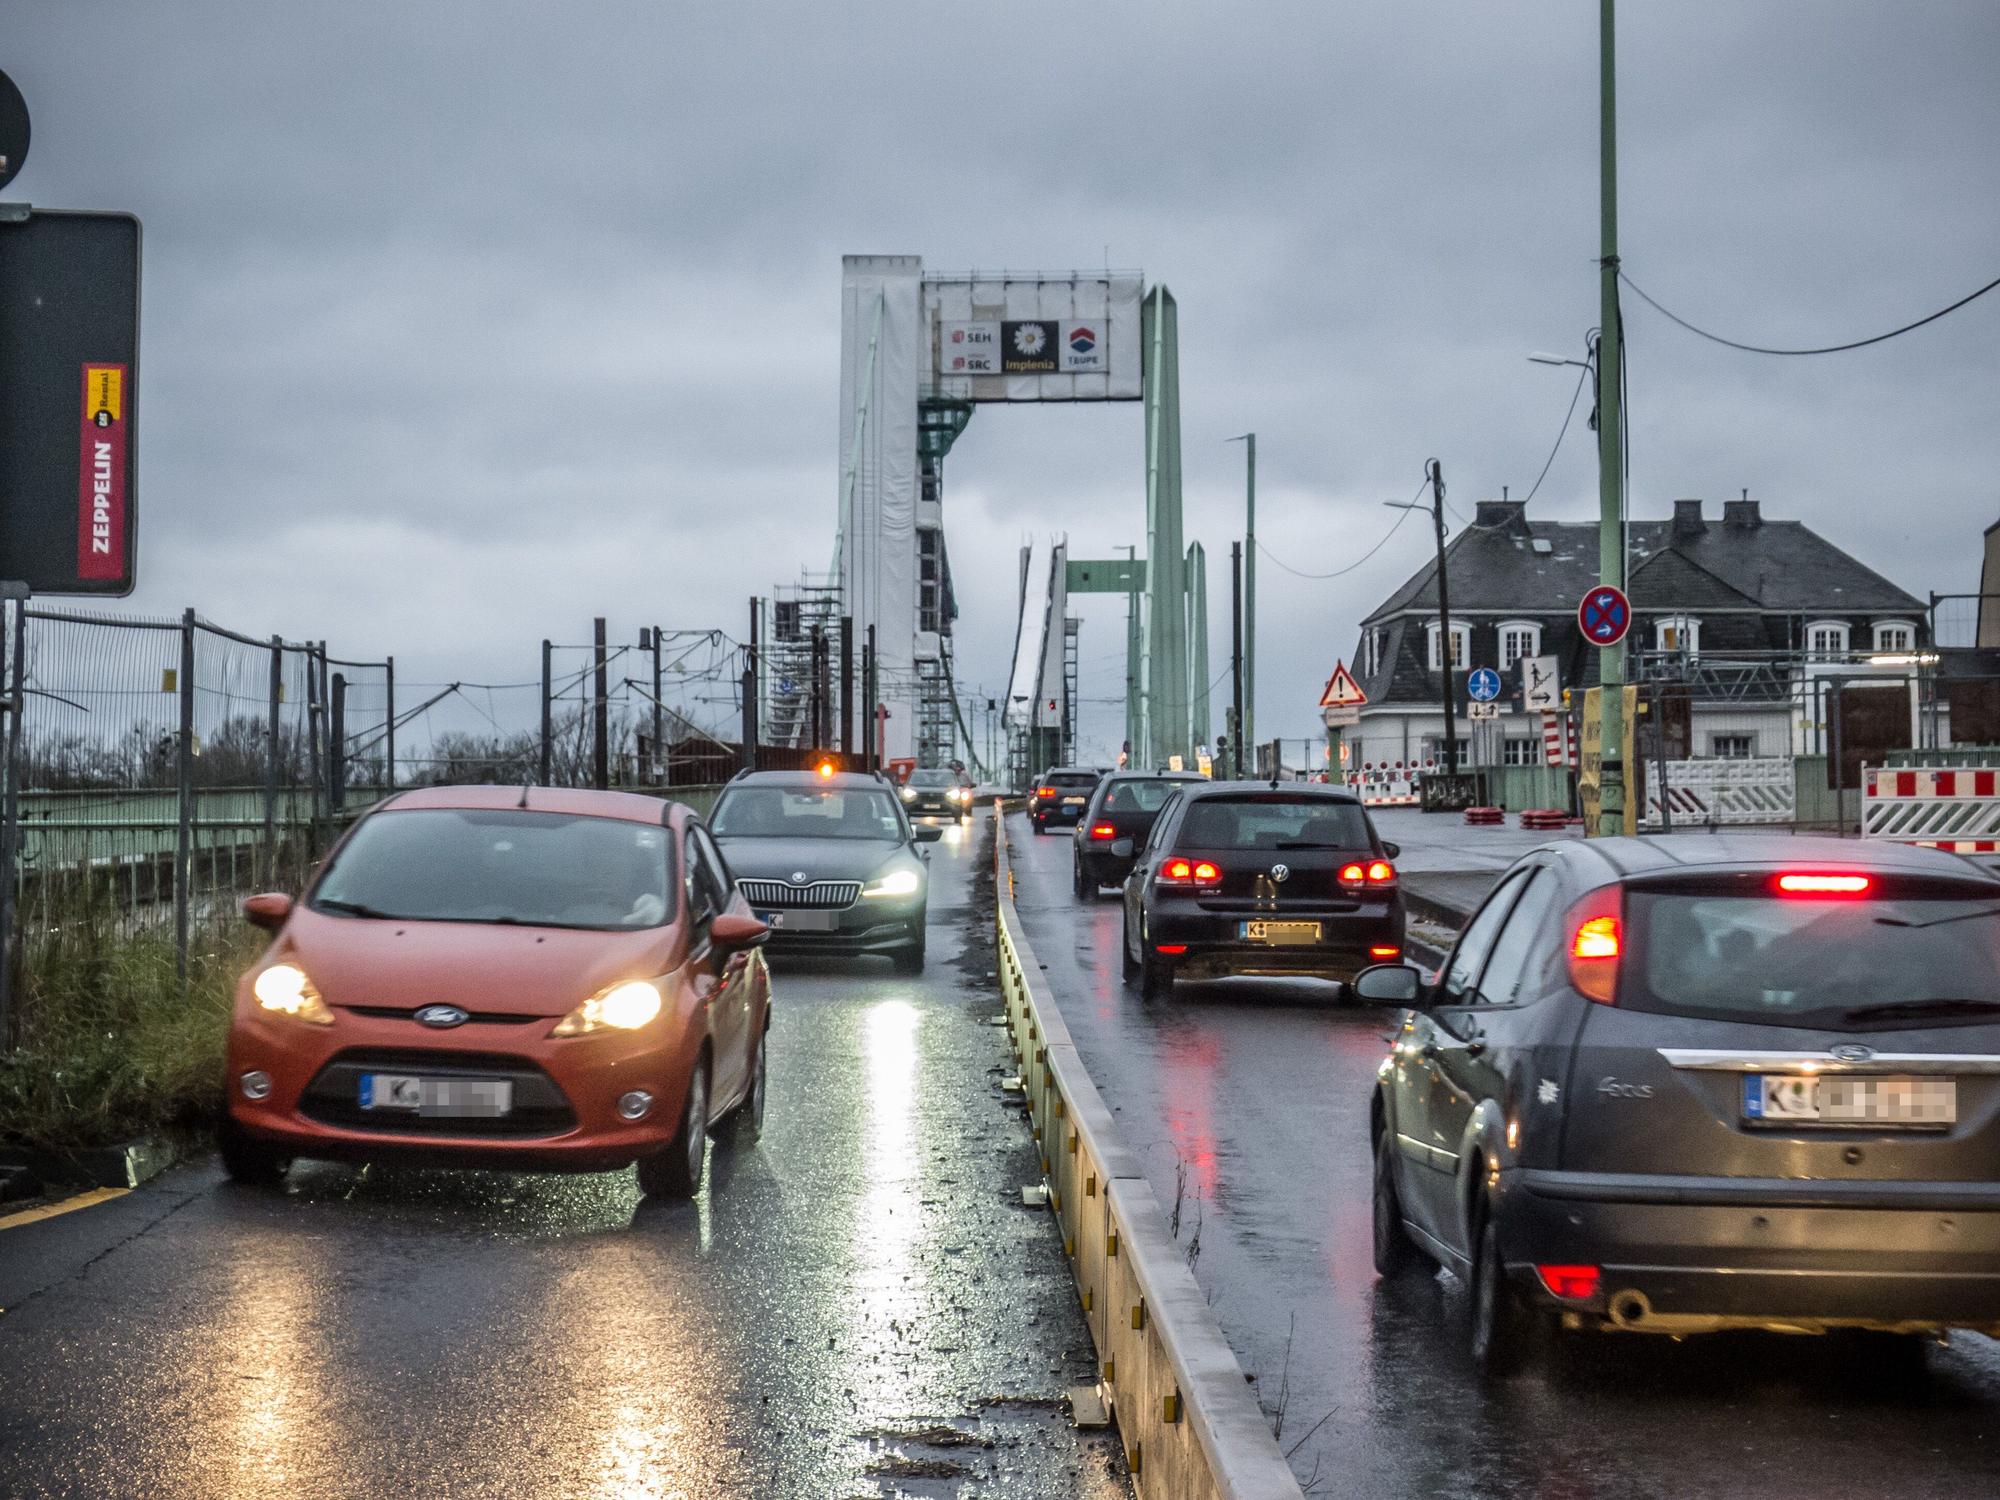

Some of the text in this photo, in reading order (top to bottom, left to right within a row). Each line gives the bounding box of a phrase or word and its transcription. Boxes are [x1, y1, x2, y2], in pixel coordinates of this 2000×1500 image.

[967, 333, 991, 343] SEH
[967, 360, 991, 370] SRC
[1006, 359, 1054, 372] Implenia
[99, 373, 109, 407] Rental
[92, 442, 111, 554] ZEPPELIN
[1248, 923, 1258, 936] K
